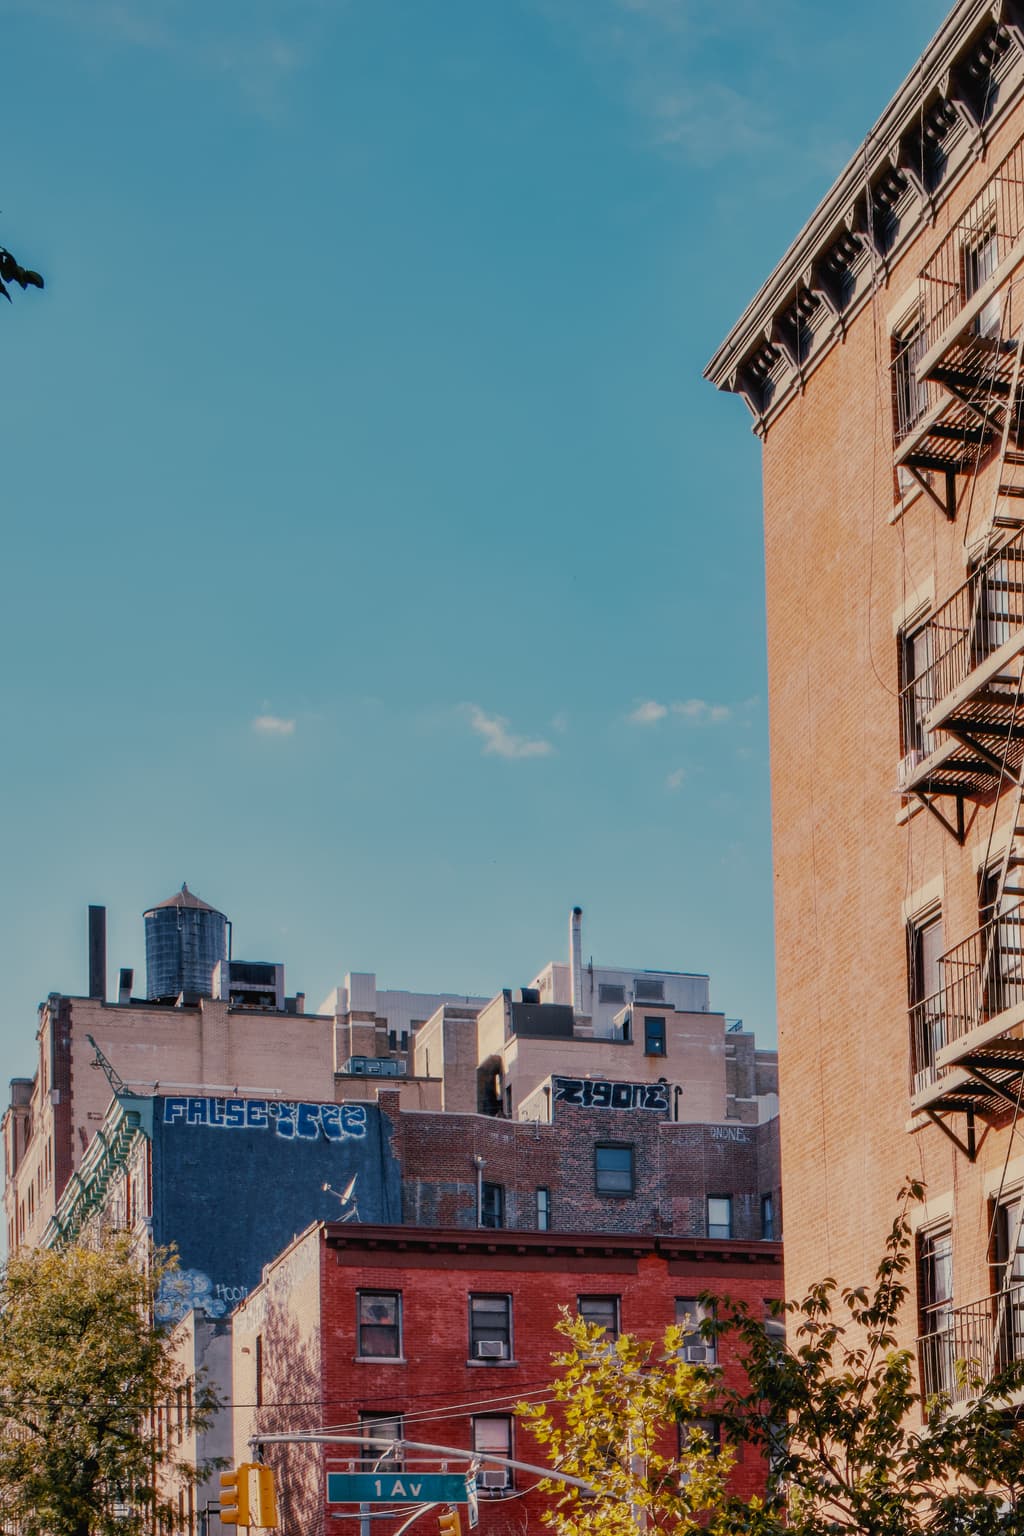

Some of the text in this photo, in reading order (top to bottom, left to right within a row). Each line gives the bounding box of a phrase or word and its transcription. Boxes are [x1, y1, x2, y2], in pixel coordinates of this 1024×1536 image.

[164, 1097, 269, 1128] FALSE
[375, 1480, 422, 1496] 1 Av
